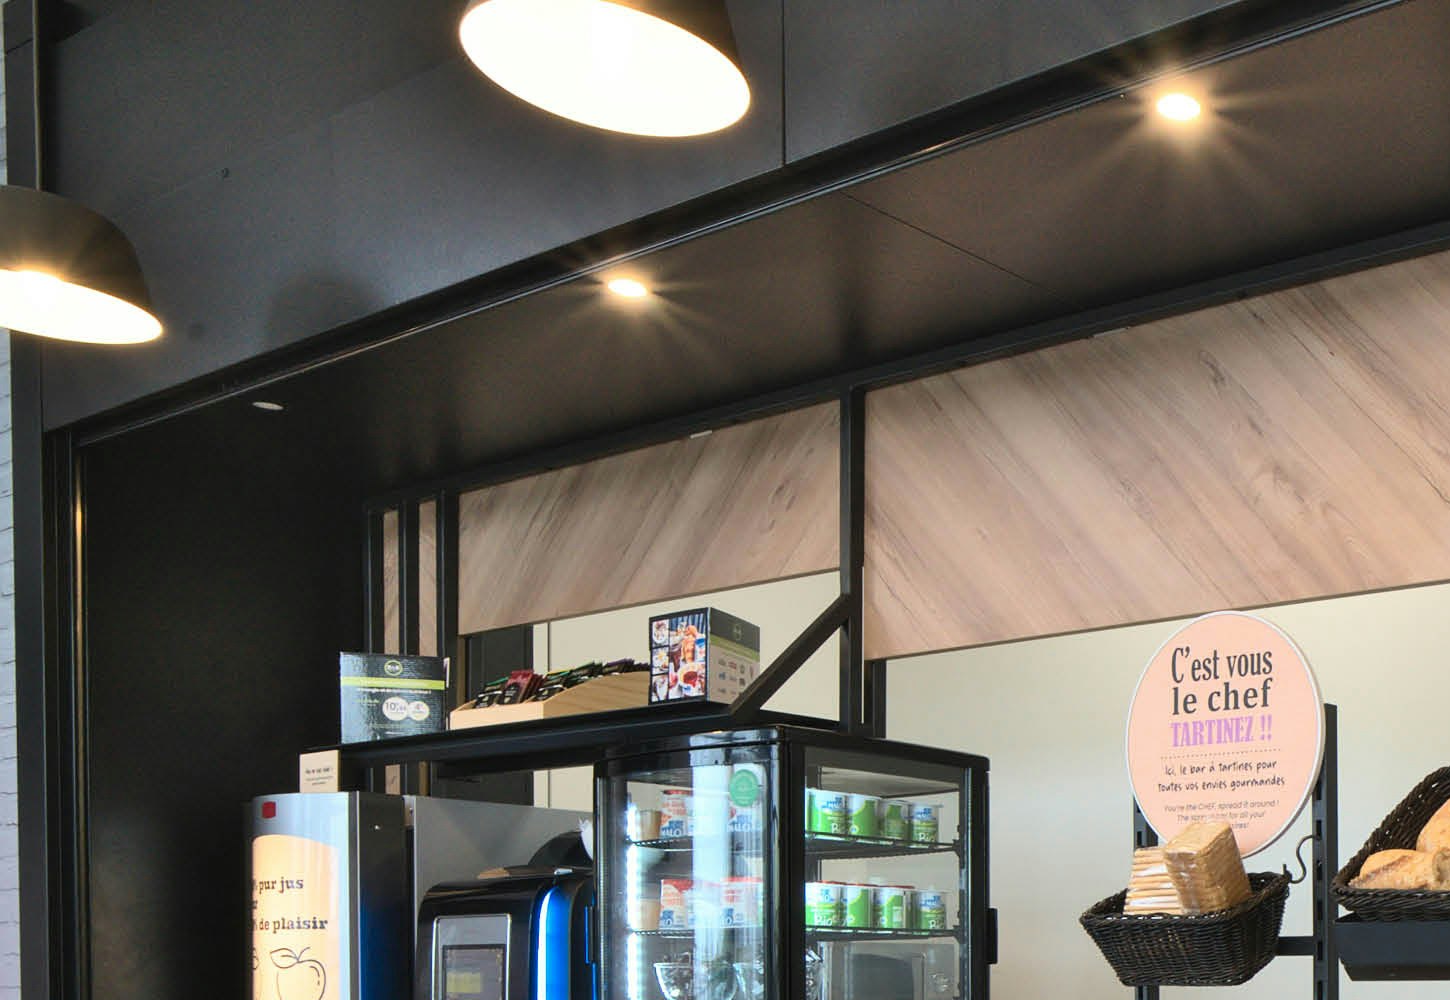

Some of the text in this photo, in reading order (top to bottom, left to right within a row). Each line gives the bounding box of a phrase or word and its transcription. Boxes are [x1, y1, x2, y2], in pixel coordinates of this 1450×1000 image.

[1171, 646, 1273, 683] C'est vous
[1172, 677, 1273, 715] le chef
[1169, 714, 1273, 747] TARTINEZ !!
[1180, 764, 1187, 776] le
[1190, 764, 1206, 775] bar
[1218, 760, 1253, 773] tartines
[1256, 760, 1278, 774] pour
[1185, 782, 1199, 791] vos
[1202, 779, 1228, 790] envies
[1230, 775, 1286, 791] gourmandes
[1250, 799, 1275, 808] around
[259, 877, 304, 894] pur jus
[259, 917, 328, 934] de plaisir
